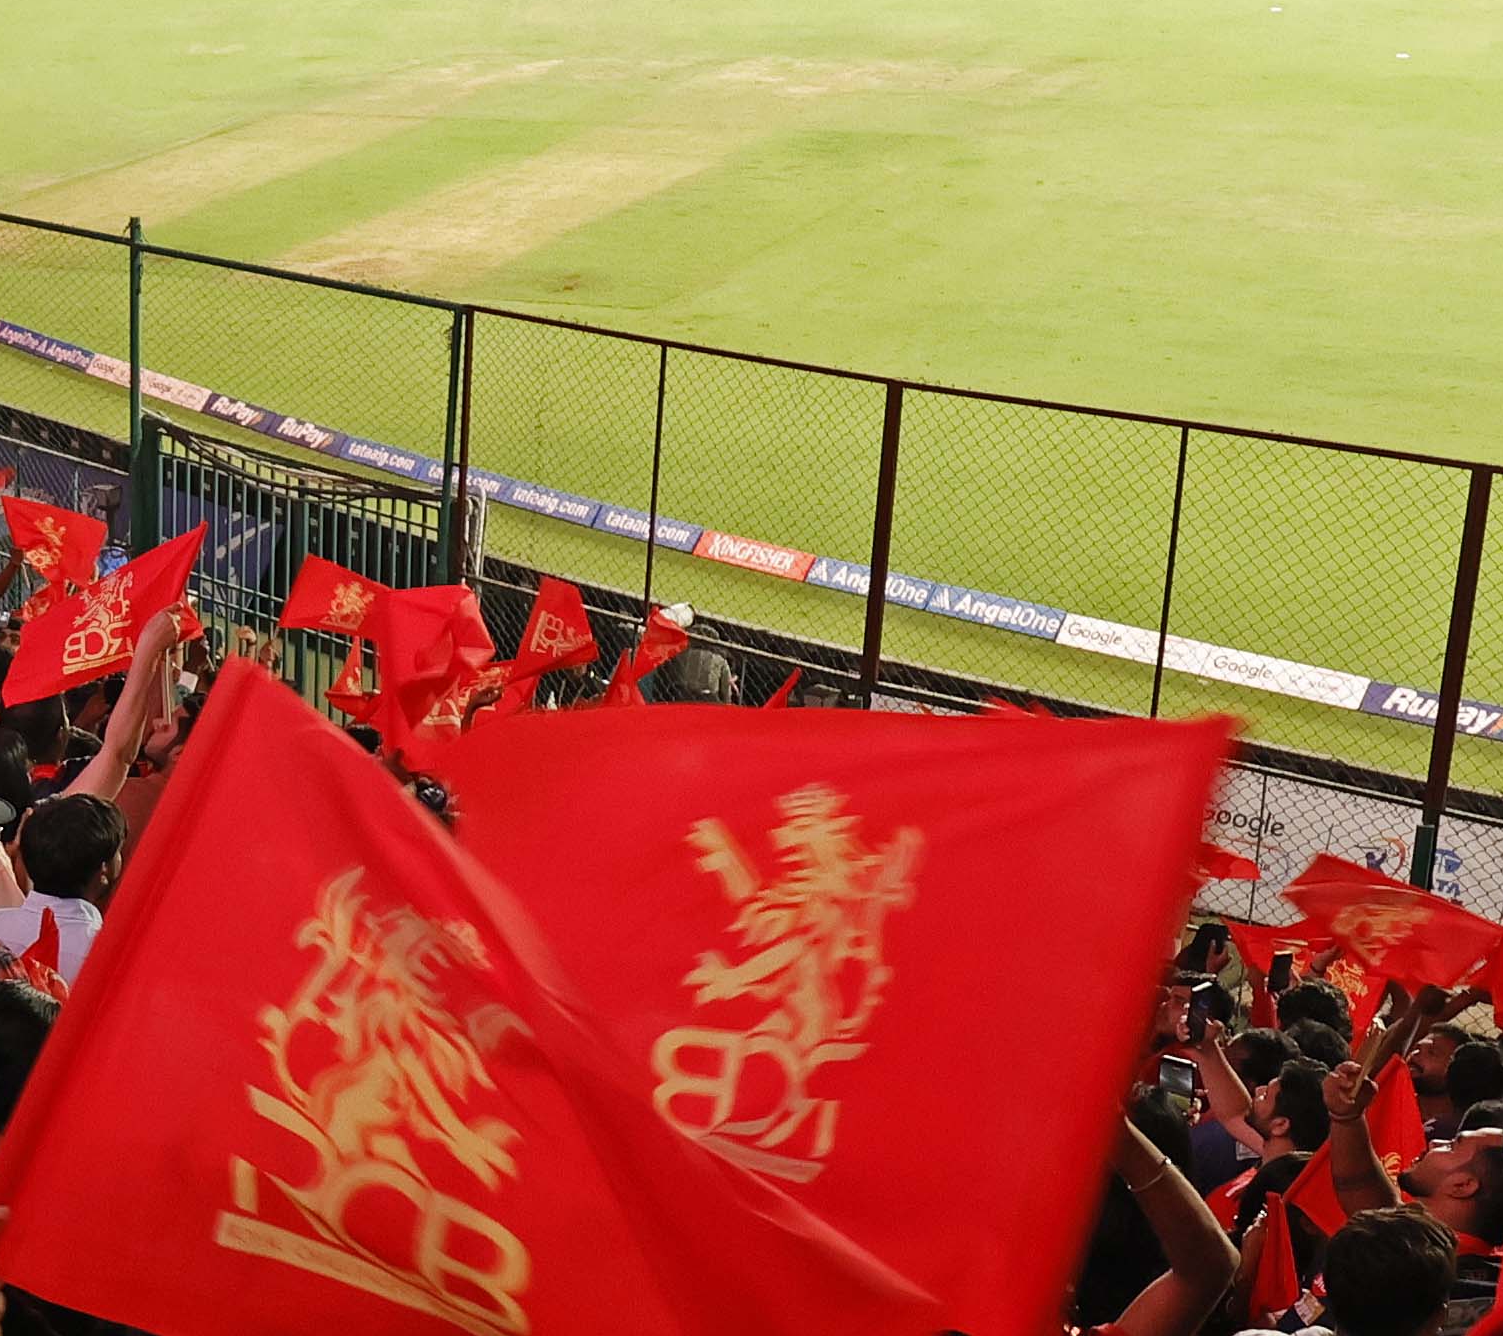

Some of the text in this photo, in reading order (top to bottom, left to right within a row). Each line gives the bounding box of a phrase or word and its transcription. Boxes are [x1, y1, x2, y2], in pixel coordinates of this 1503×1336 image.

[209, 395, 257, 426] RuPay
[275, 416, 328, 450] RuPay
[348, 442, 417, 473] tataaig.com
[512, 482, 590, 519] tataaig.com
[709, 532, 796, 571] KINGFISHER
[835, 565, 928, 605] AnglOne
[954, 594, 1059, 635] AngelOne
[1068, 619, 1123, 647] Google
[1213, 653, 1274, 680] Google
